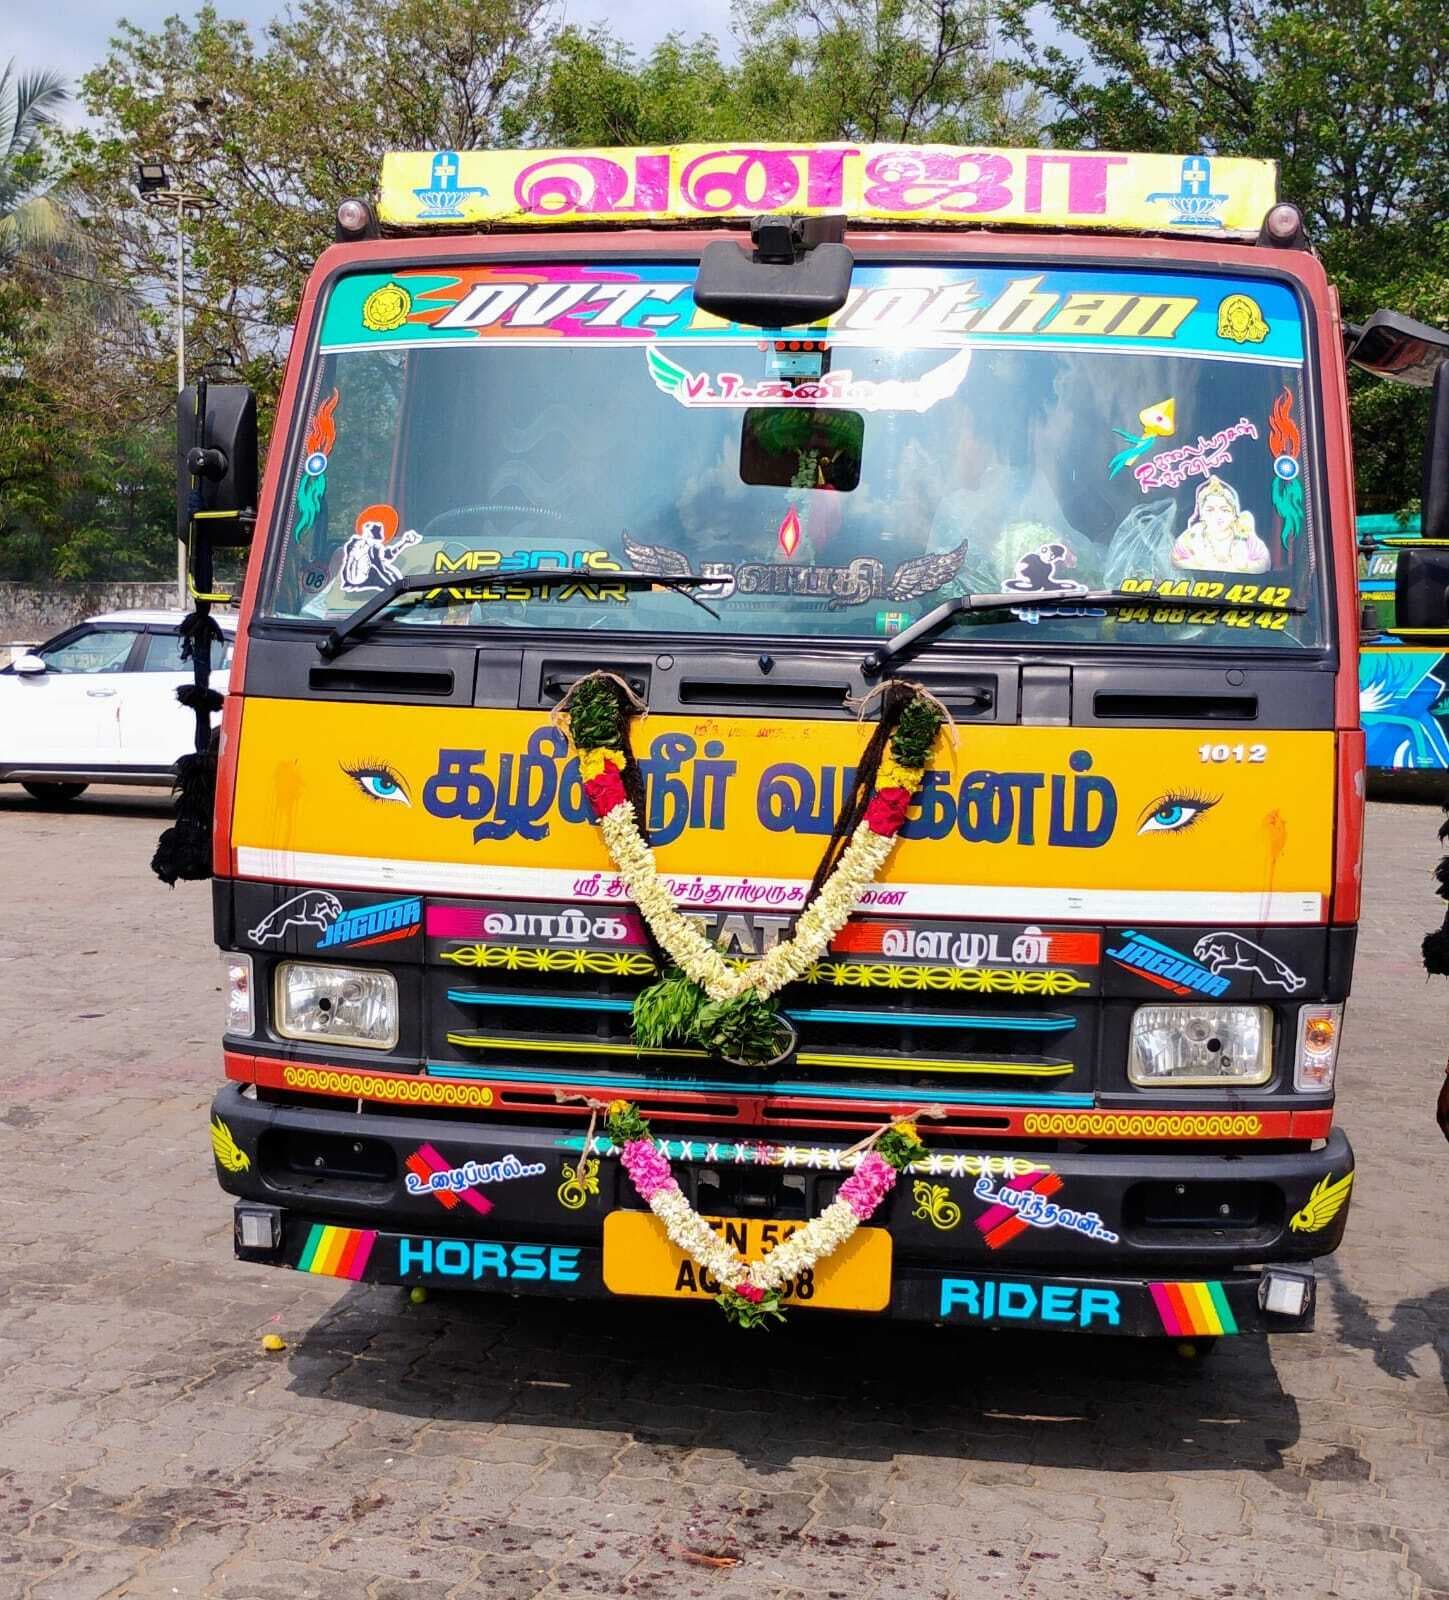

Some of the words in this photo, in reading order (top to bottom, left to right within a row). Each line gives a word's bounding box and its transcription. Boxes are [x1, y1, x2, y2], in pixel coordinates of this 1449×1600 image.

[513, 148, 1128, 215] வனஜா
[1225, 584, 1259, 604] 42
[1256, 586, 1292, 608] 42
[1253, 611, 1290, 631] 42
[1197, 743, 1268, 764] 1012
[316, 899, 422, 949] JAGUAR
[482, 907, 628, 944] வாழ்க
[881, 925, 1053, 969] வளமுடன்
[1104, 941, 1232, 998] JAGUAR
[399, 1238, 582, 1282] HORSE
[939, 1277, 1121, 1329] RIDER
